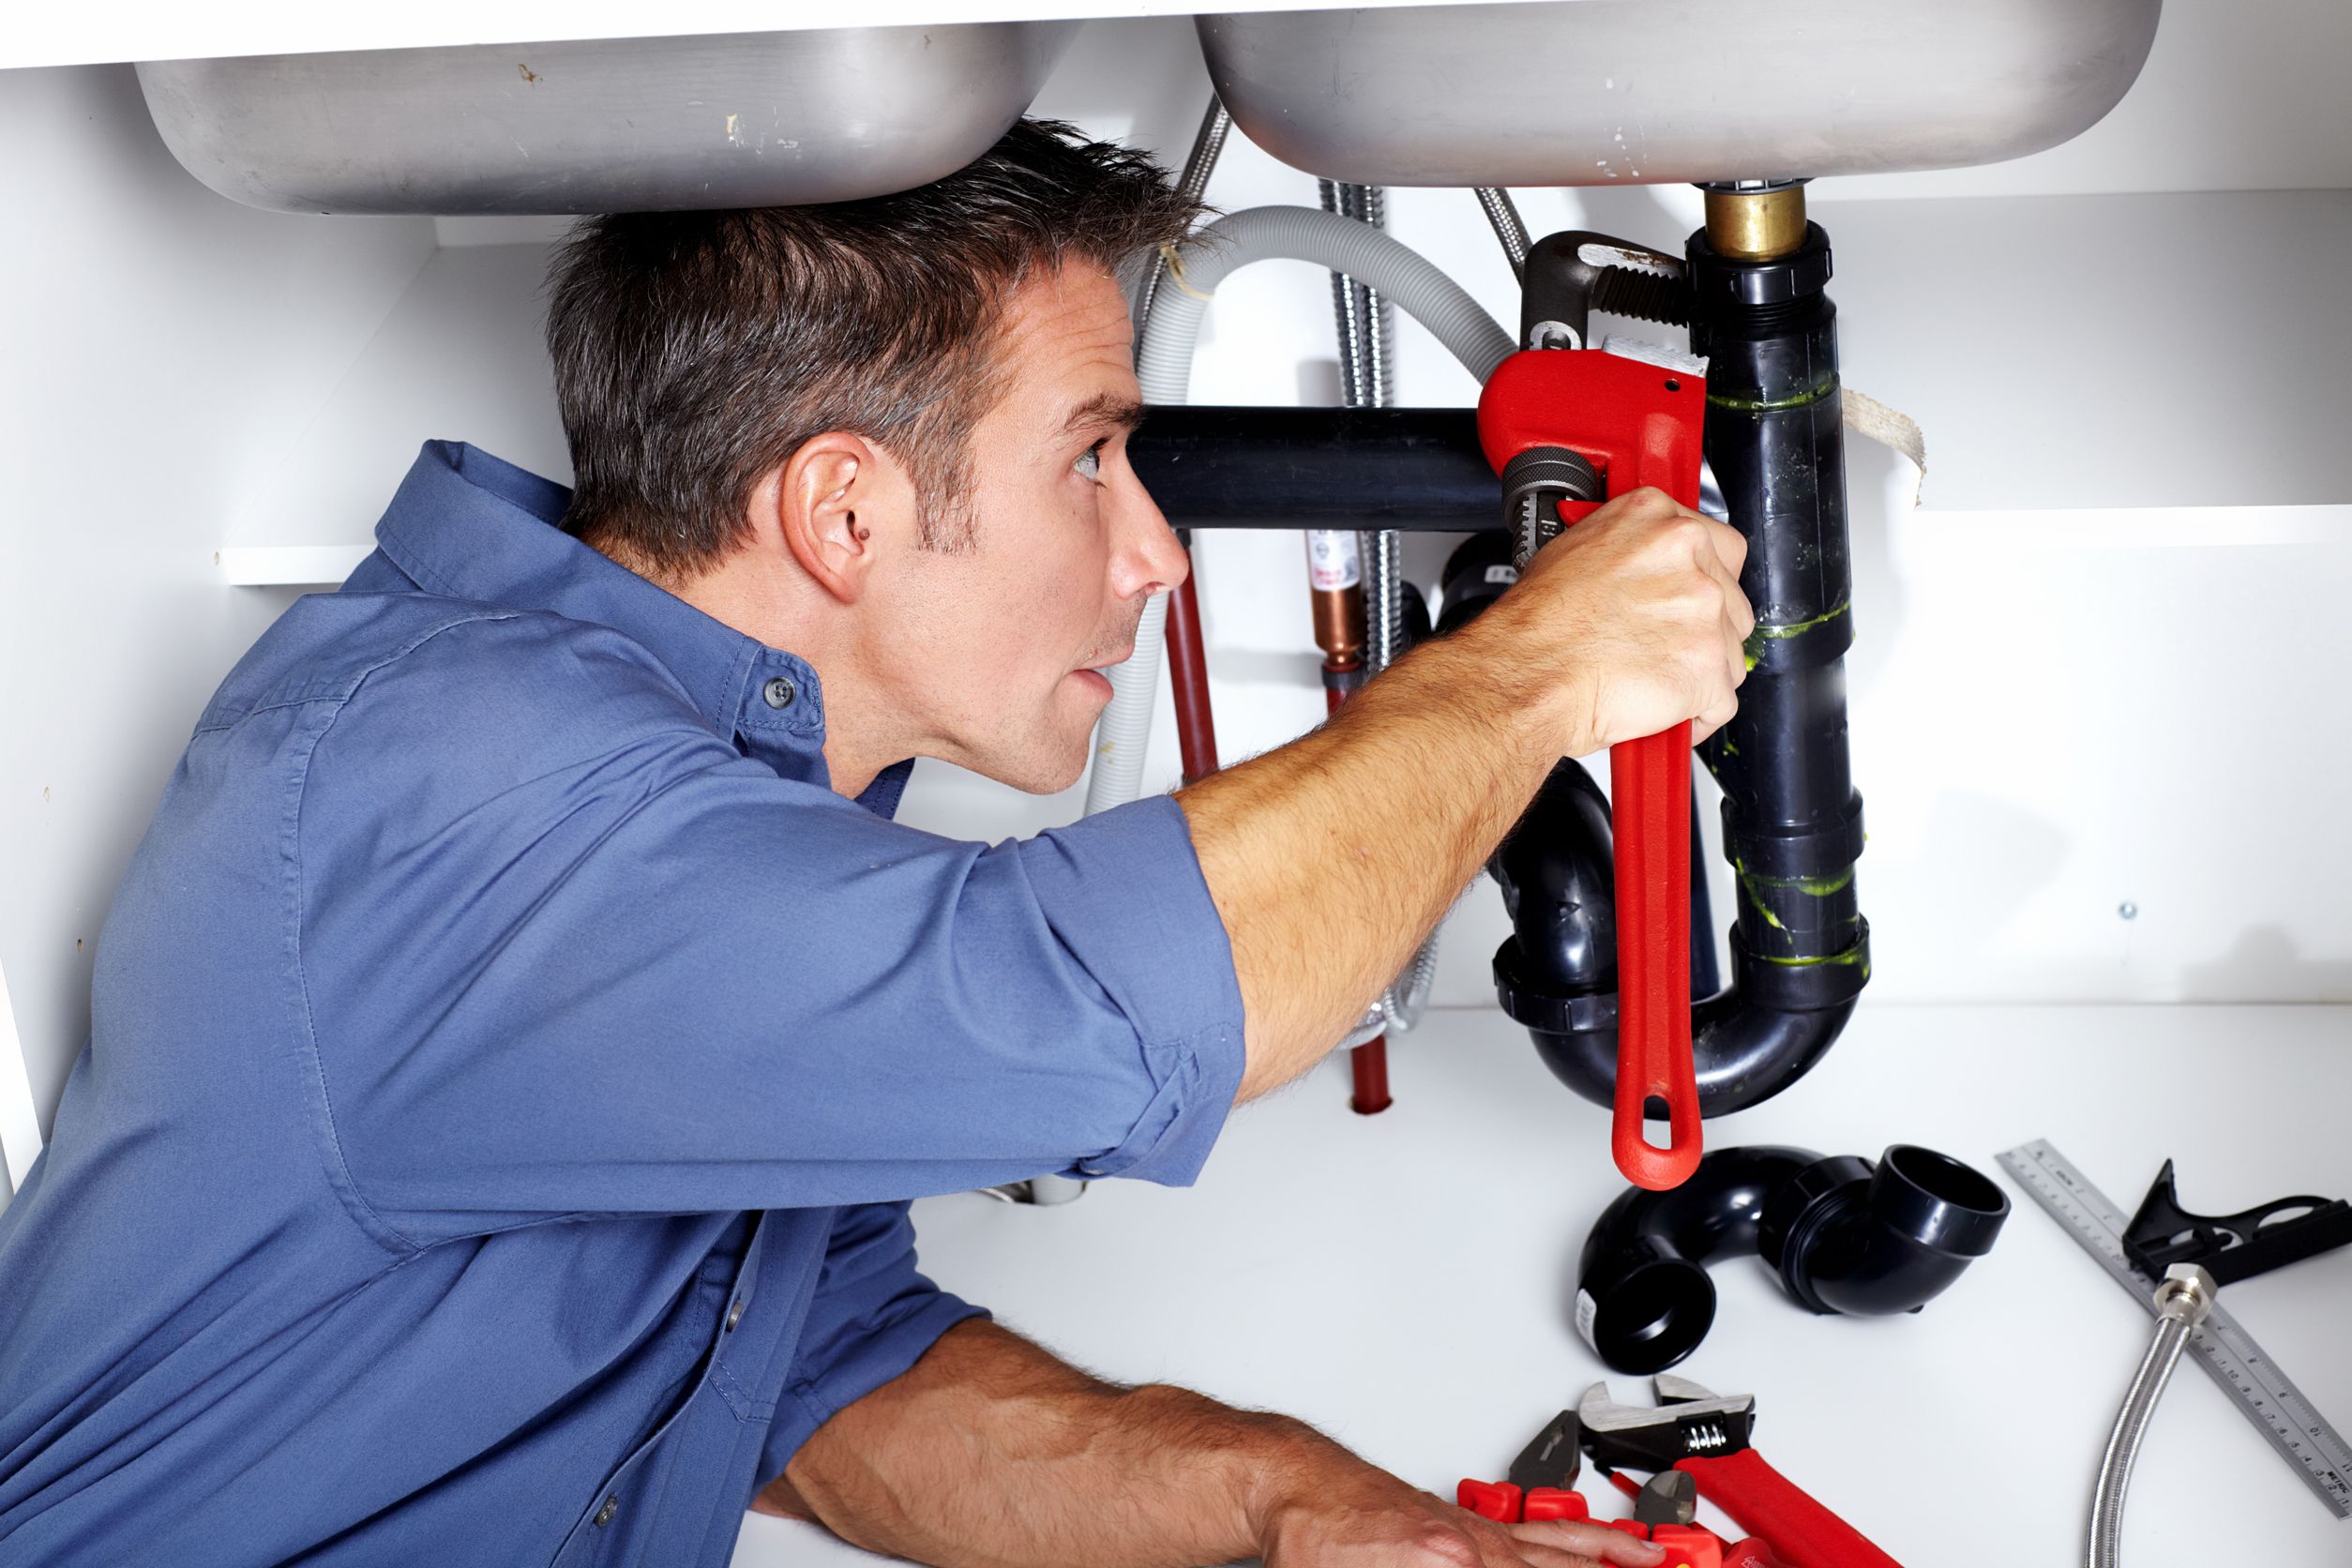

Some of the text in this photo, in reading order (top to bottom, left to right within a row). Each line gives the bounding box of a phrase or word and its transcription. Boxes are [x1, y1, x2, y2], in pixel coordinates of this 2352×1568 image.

[1541, 519, 1558, 536] 18
[2228, 1369, 2239, 1380] 10
[2327, 1470, 2350, 1494] METRIC
